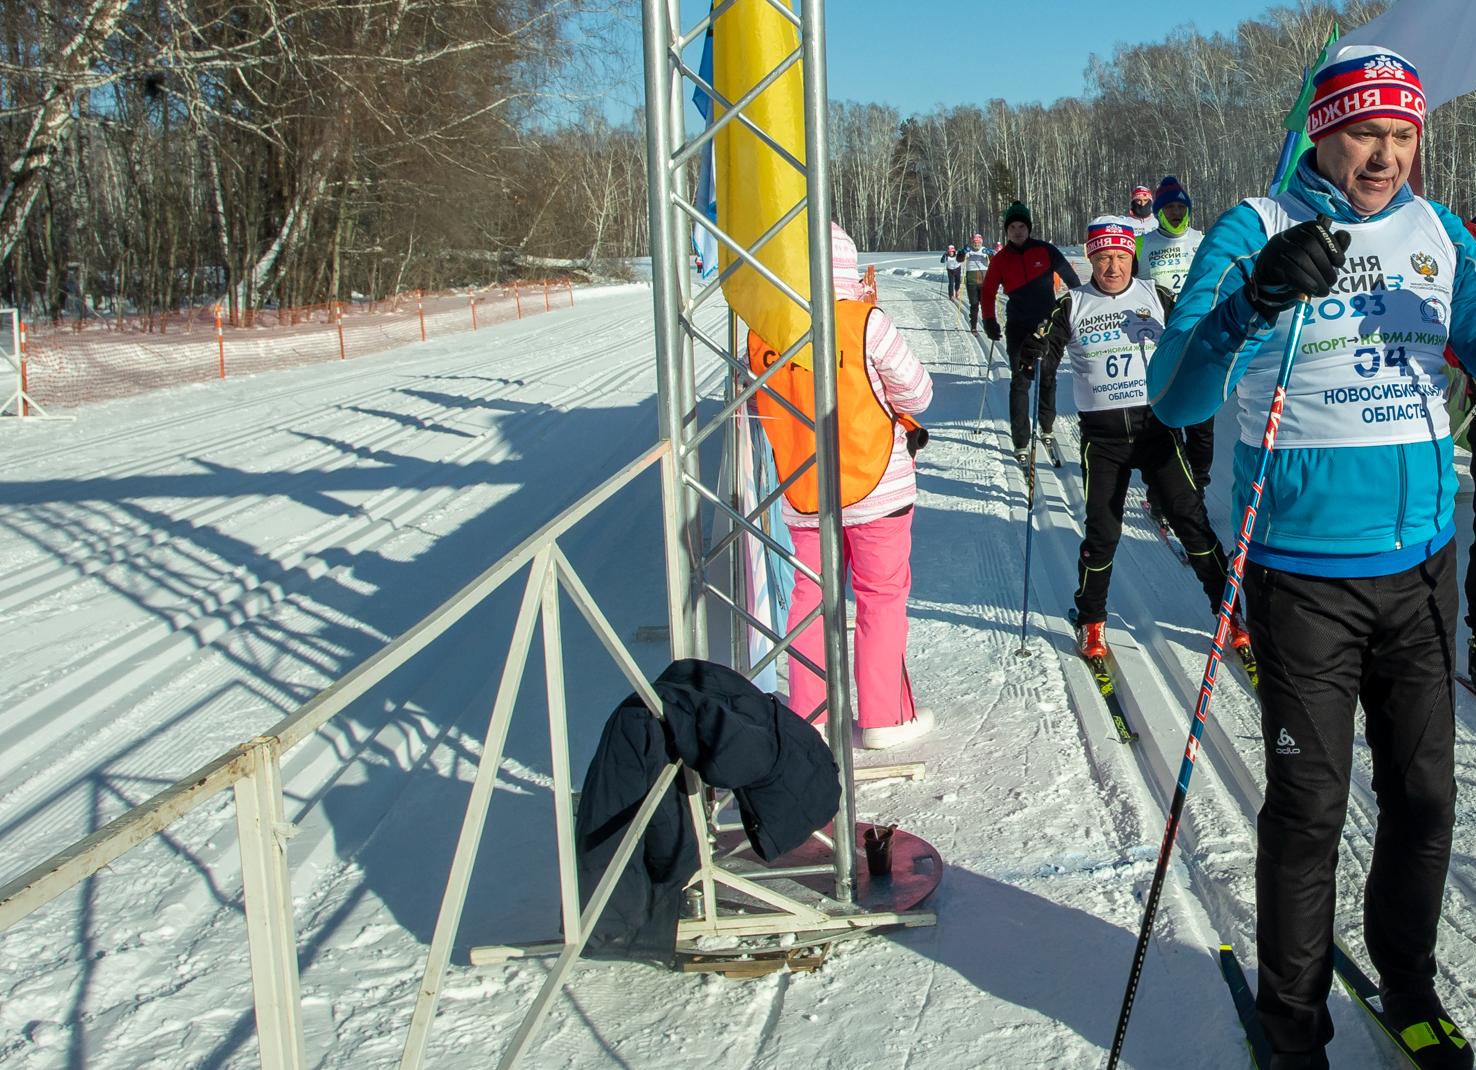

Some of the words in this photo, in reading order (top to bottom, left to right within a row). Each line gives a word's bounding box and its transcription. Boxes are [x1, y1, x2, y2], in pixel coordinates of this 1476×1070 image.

[1150, 259, 1181, 269] 2023
[1303, 294, 1387, 325] 2023
[1078, 312, 1119, 328] ЛЫЖНЯ
[1078, 320, 1121, 336] РОССИИ
[1080, 330, 1121, 346] 2023
[1301, 336, 1347, 354] СПОРТ
[1360, 331, 1413, 345] НОРМА
[1105, 353, 1133, 379] 67
[1108, 389, 1144, 401] ОБЛАСТЬ
[1324, 383, 1440, 405] НОВОСИБИРСКАЯ
[1362, 403, 1427, 423] ОБЛАСТЬ
